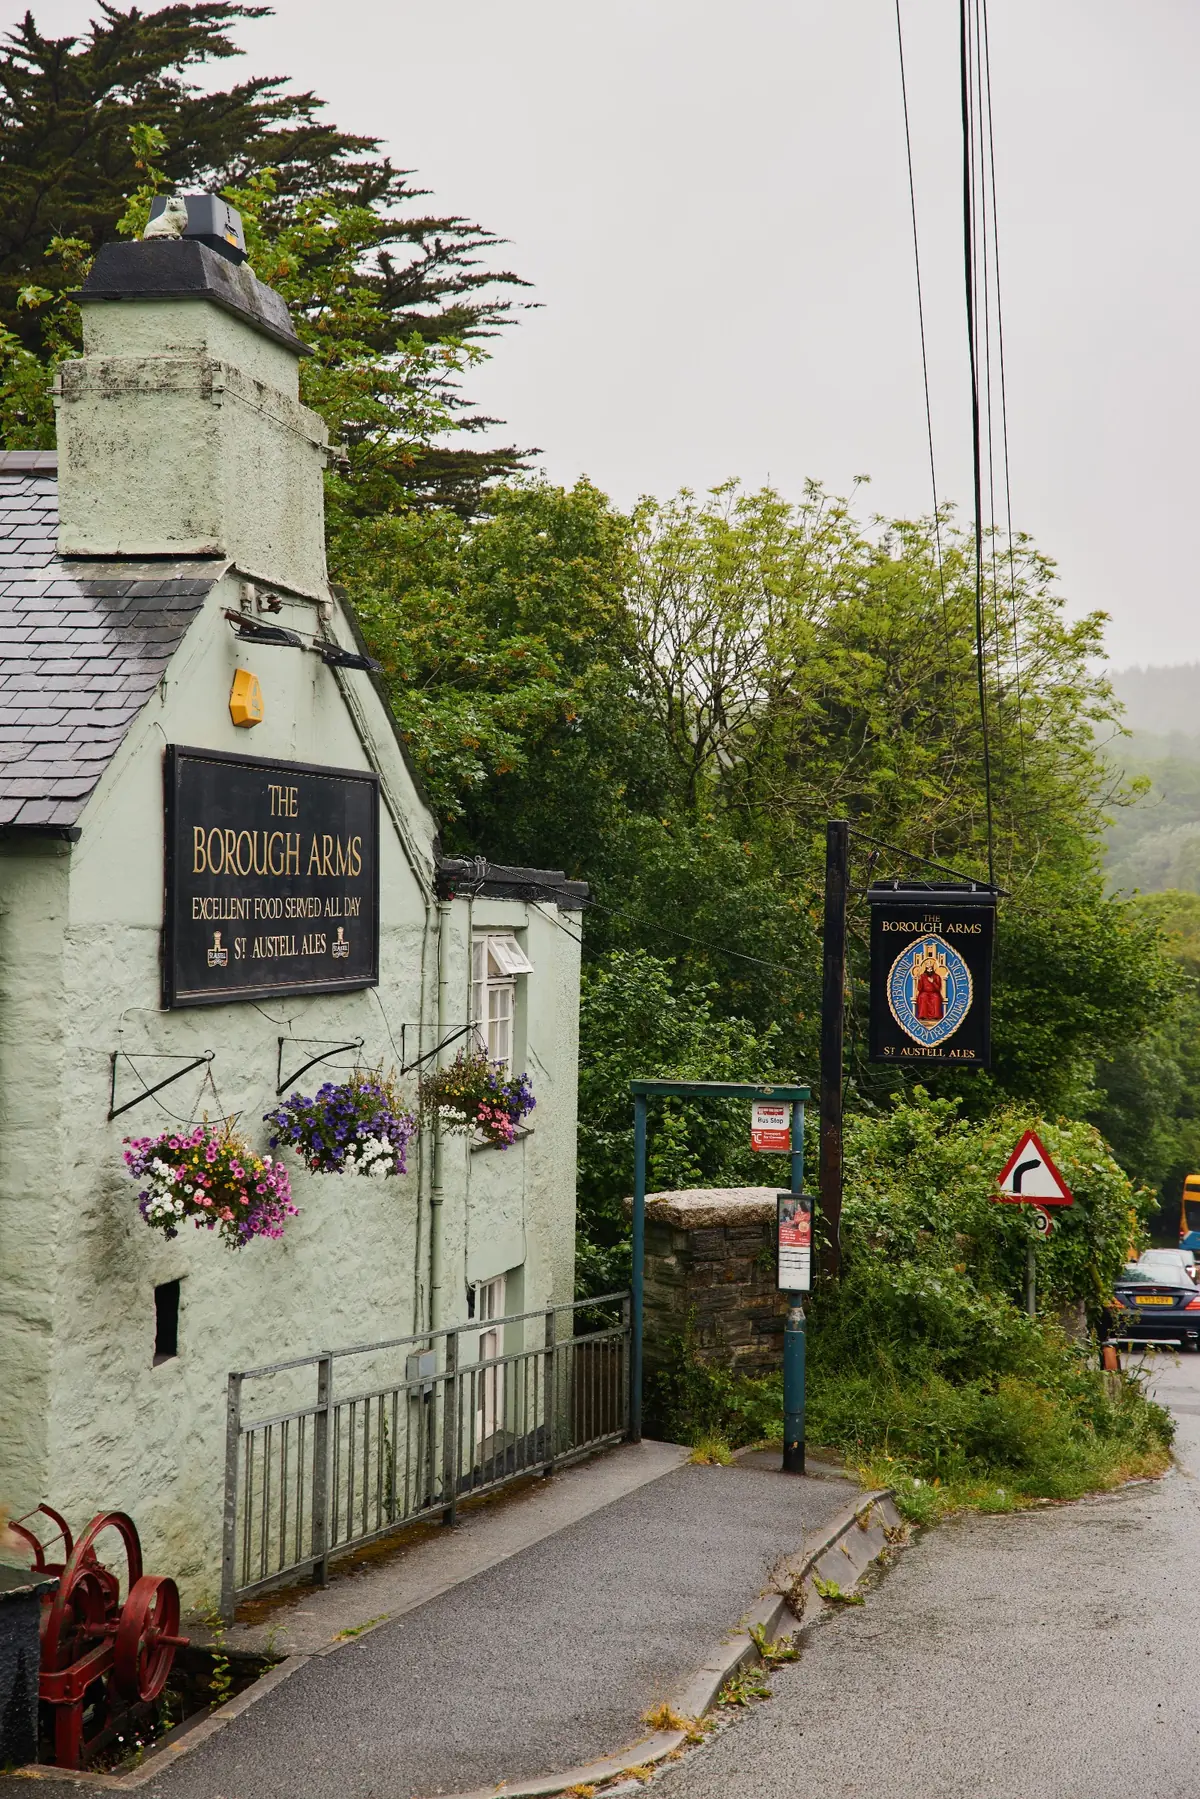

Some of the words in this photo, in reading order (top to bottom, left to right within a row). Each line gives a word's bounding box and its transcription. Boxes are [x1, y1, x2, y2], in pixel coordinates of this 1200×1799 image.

[267, 784, 299, 818] THE
[192, 826, 300, 876] BOROUGH
[306, 833, 362, 877] ARMS
[192, 897, 251, 920] EXCELLENT
[254, 897, 283, 920] FOOD
[285, 897, 321, 918] SERVED
[324, 897, 342, 917] ALL
[344, 897, 361, 917] DAY
[882, 921, 943, 933] BOROUGH
[946, 923, 982, 934] ARMS
[923, 914, 941, 923] THE
[252, 935, 299, 959] AUSTELL
[301, 933, 327, 955] ALES
[900, 1047, 946, 1057] AUSTELL
[948, 1049, 976, 1058] ALES
[770, 1117, 784, 1125] Stop
